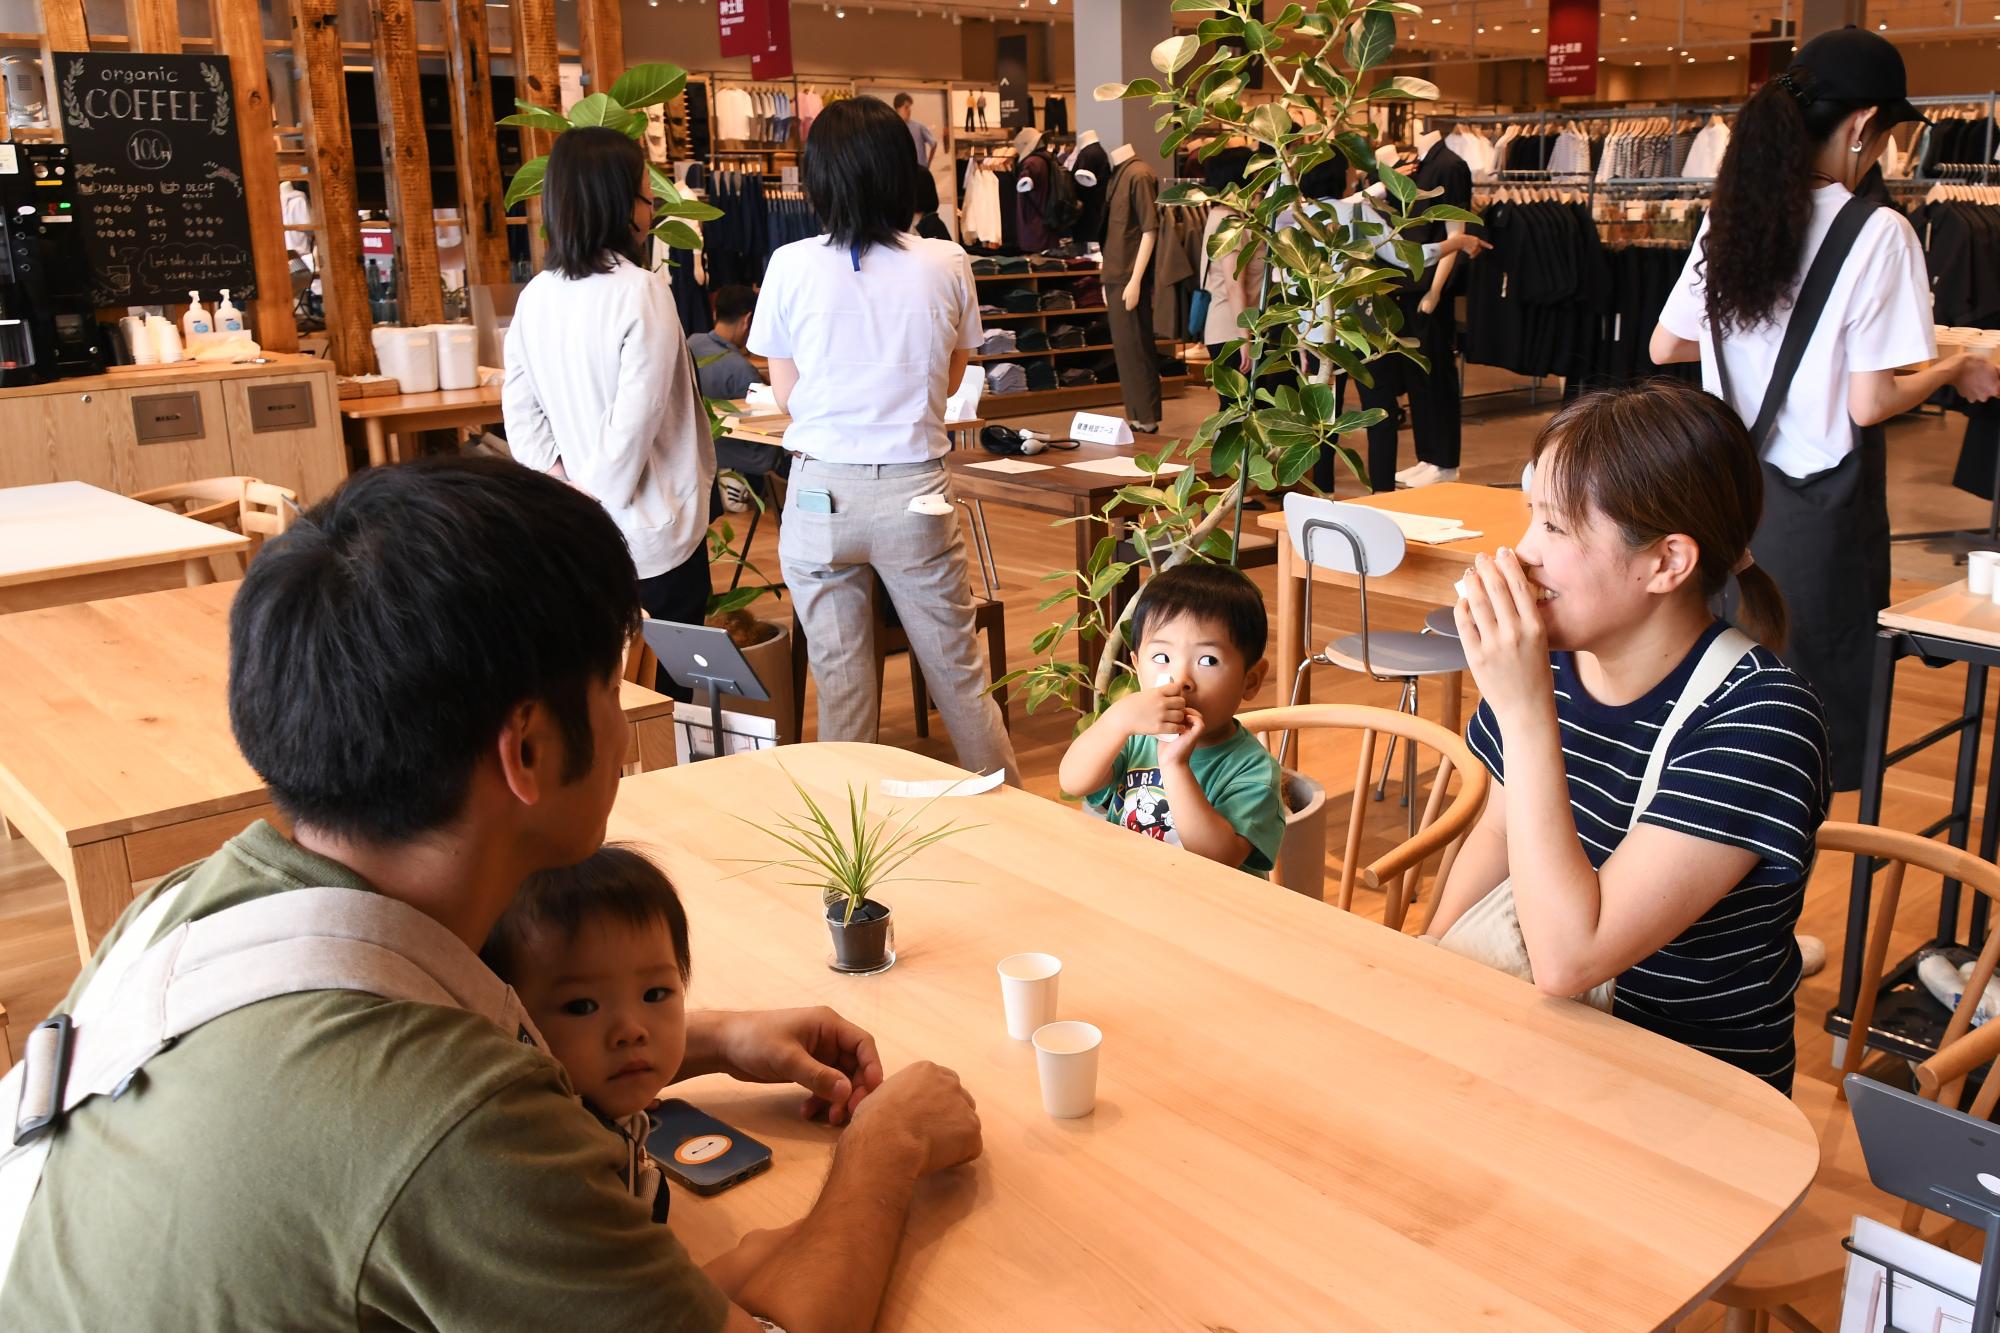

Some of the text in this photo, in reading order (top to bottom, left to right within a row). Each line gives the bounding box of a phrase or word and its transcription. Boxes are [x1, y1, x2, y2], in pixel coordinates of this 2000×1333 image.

[101, 66, 179, 84] organic
[85, 88, 209, 122] COFFEE
[185, 182, 216, 193] DECAF
